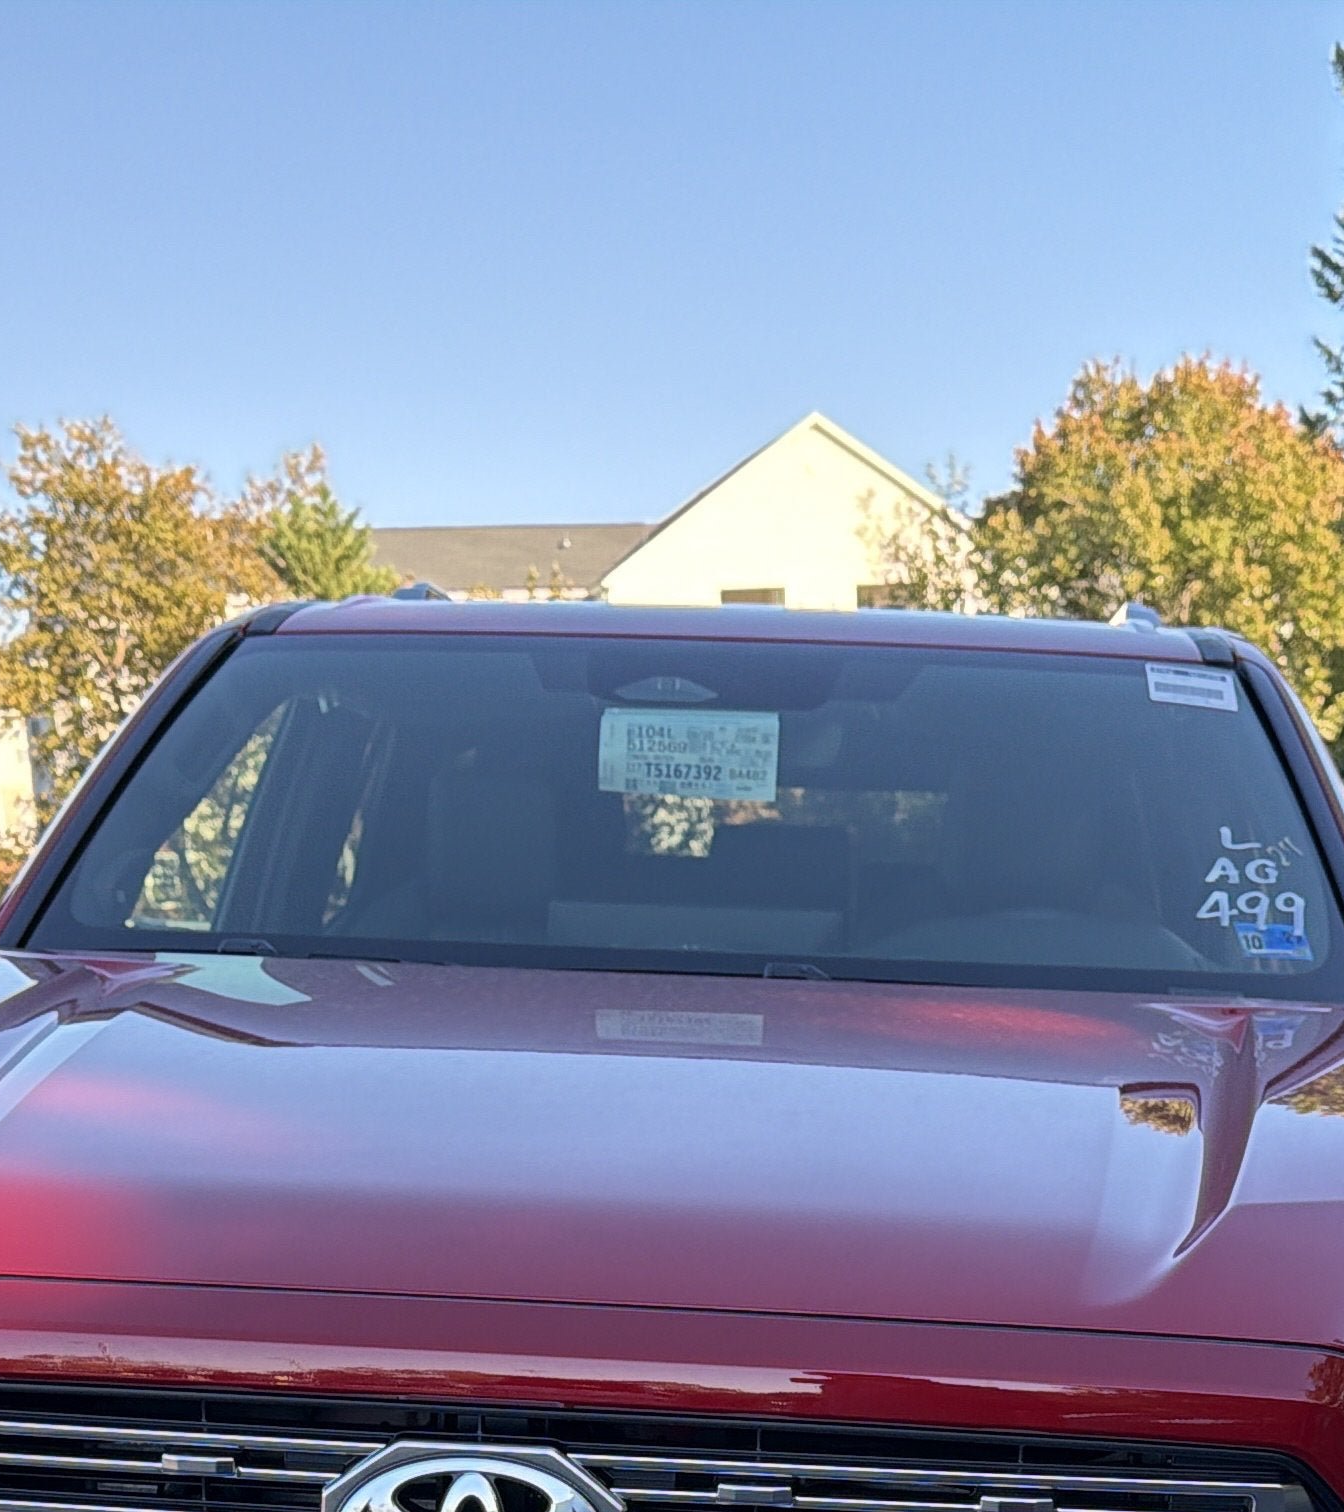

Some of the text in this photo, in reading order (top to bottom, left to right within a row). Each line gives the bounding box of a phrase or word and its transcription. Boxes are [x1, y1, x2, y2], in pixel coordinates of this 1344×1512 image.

[644, 762, 722, 781] T5167392
[1219, 826, 1262, 850] L
[1196, 890, 1306, 936] 499
[1243, 933, 1264, 951] 10
